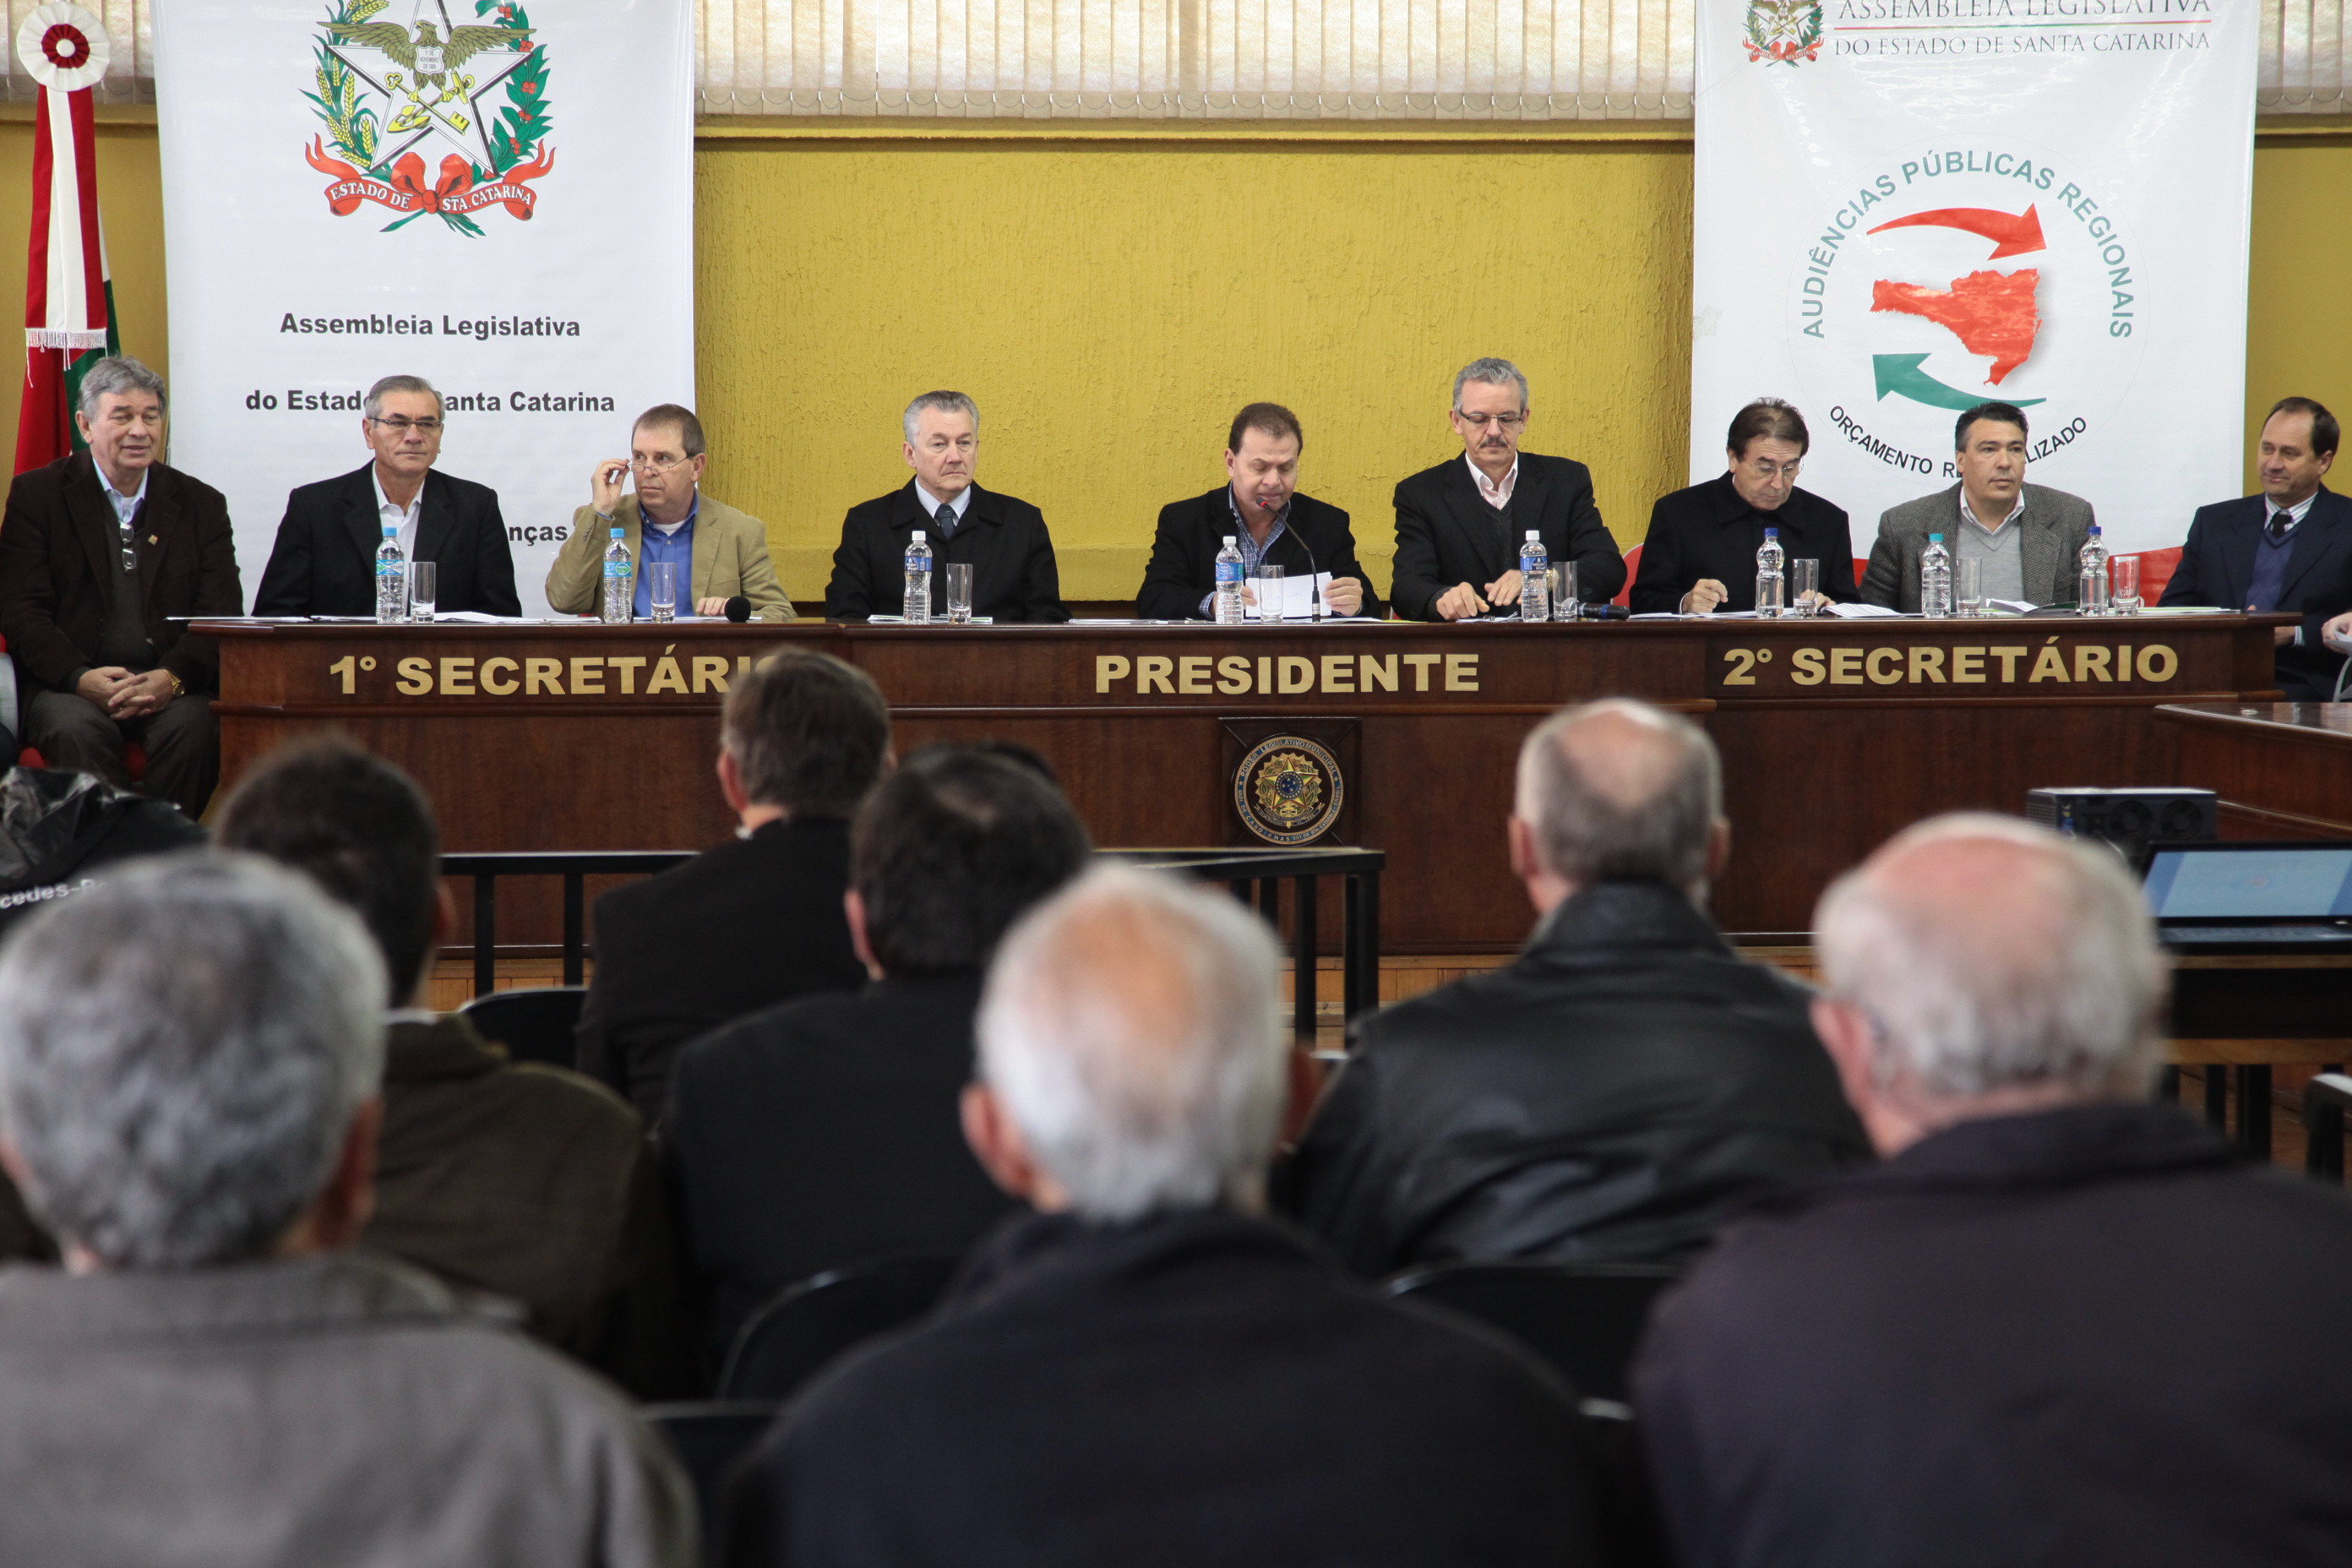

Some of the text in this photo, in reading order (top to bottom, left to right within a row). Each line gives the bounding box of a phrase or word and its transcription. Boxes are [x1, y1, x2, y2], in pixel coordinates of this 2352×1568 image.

[1839, 0, 2014, 19] ASSEMBLEIA
[1835, 31, 2212, 56] DO ESTADO DE SANTA CATARINA
[330, 182, 388, 201] ESTADO
[389, 193, 411, 210] DE
[471, 185, 531, 205] CATARINA
[1801, 150, 2135, 339] AUDIÊNCIAS PÚBLICAS REGIONAIS
[280, 313, 581, 341] Assembleia Legislativa
[246, 389, 278, 411] do
[445, 392, 501, 411] anta
[509, 391, 615, 412] Catarina
[1829, 406, 2087, 478] ORÇAMENTO RLIZADO
[509, 525, 569, 547] nças
[395, 643, 778, 696] SECRETÁRI
[1095, 654, 1479, 695] PRESIDENTE
[1789, 635, 2179, 686] SECRETÁRIO
[1240, 739, 1337, 776] PODER LEGISLATIVO MUNICIPAL
